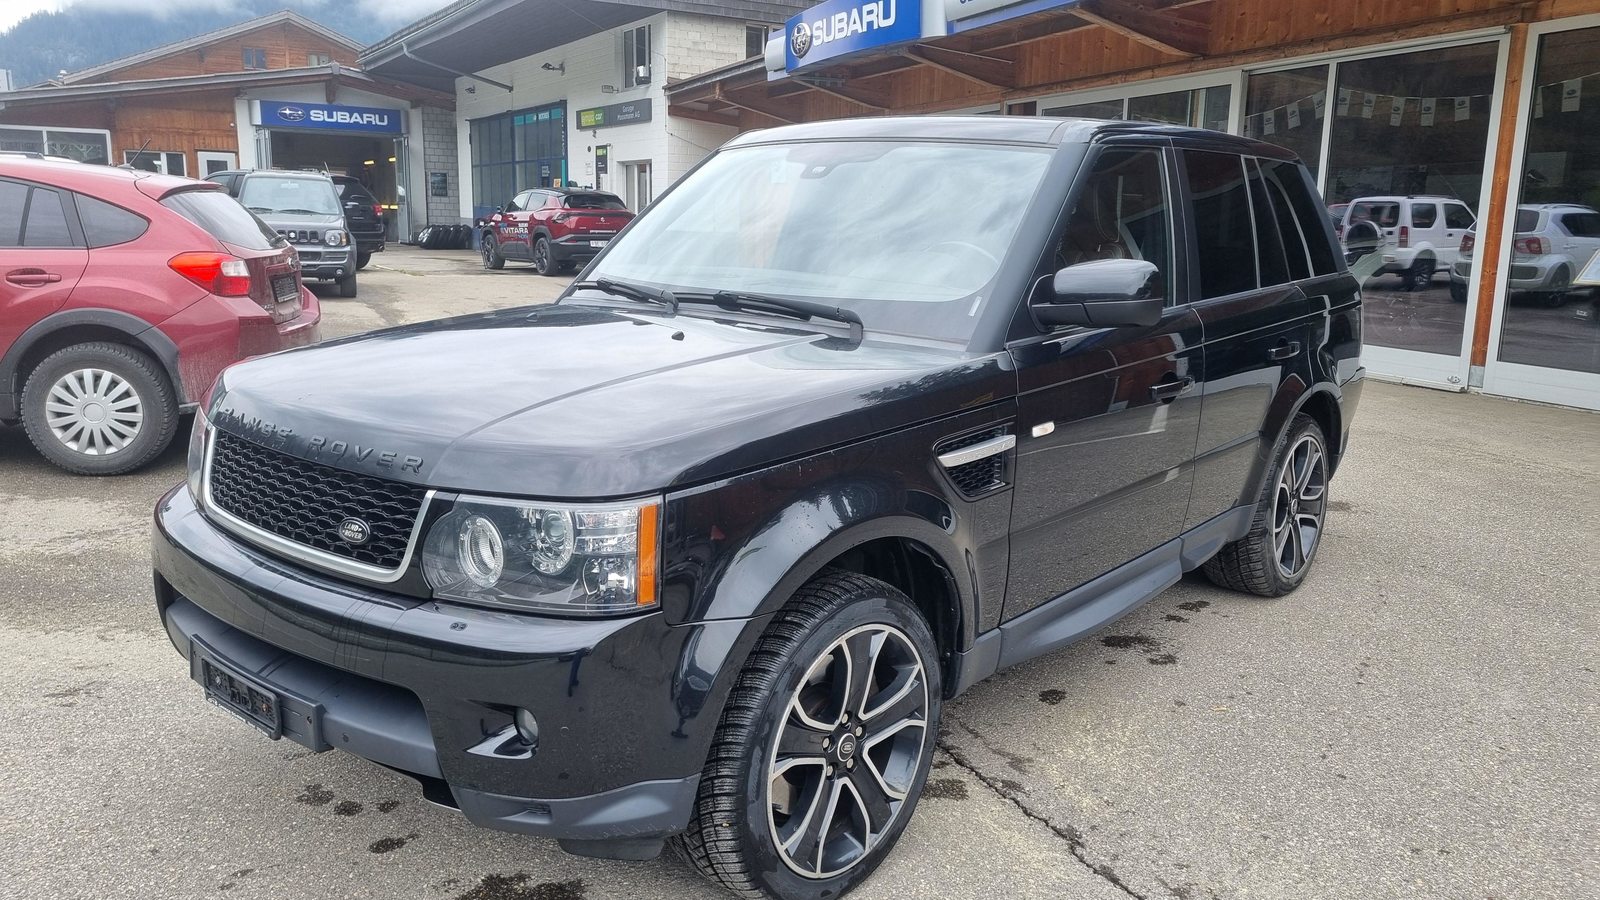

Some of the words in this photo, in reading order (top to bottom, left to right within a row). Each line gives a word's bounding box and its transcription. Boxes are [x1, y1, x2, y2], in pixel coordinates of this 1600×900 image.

[812, 0, 896, 46] SUBARU
[309, 109, 388, 126] SUBARU
[308, 435, 424, 475] ROVER
[344, 522, 359, 532] LAND
[344, 529, 363, 540] ROVER
